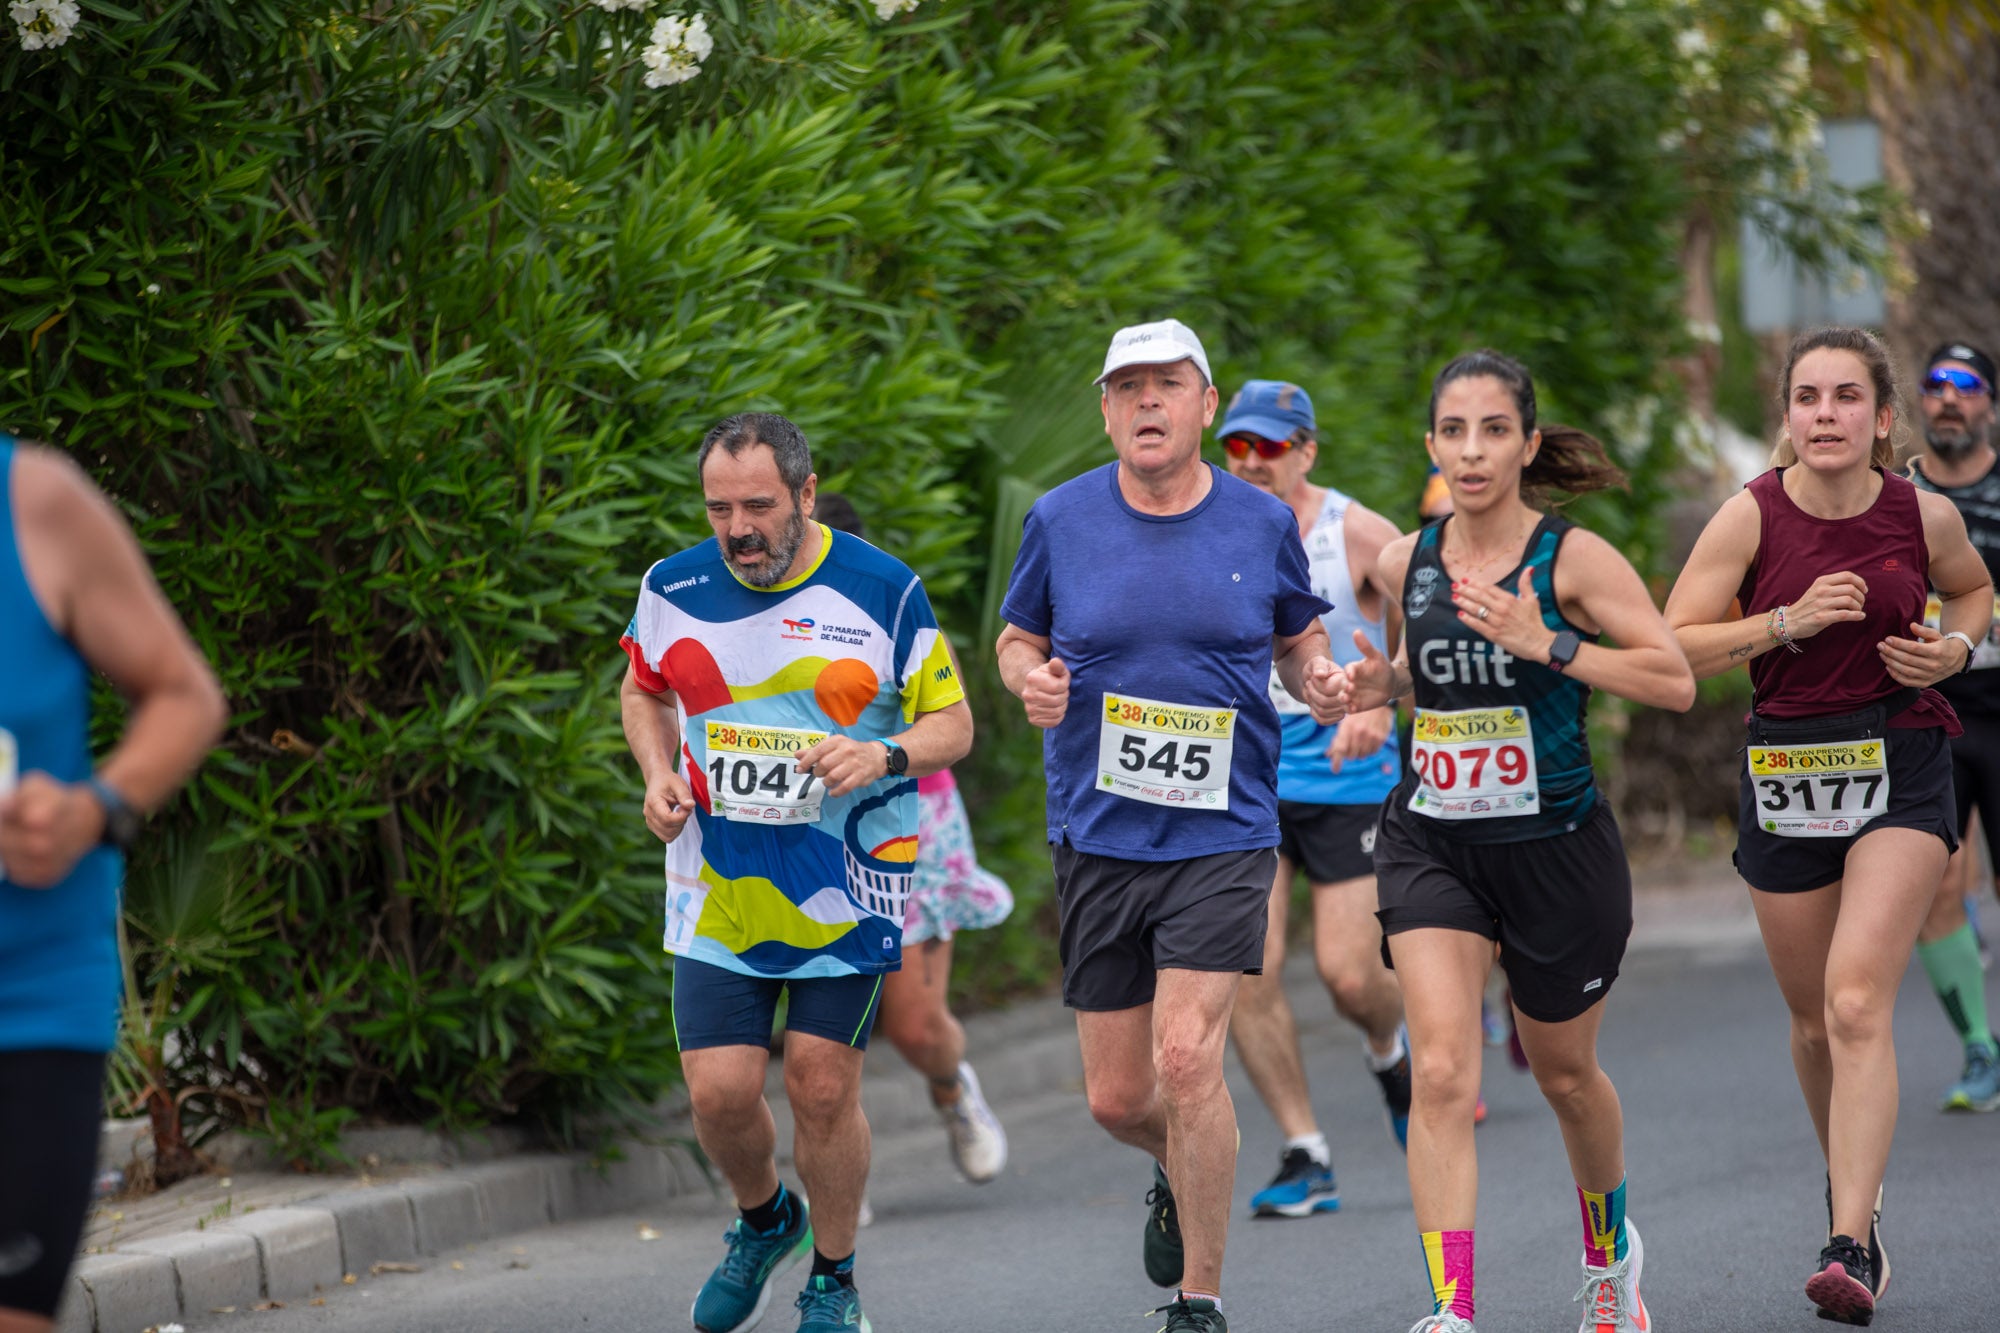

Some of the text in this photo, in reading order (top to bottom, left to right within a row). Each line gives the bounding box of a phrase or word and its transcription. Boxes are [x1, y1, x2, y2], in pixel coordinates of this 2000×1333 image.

[663, 576, 697, 594] luanvi
[820, 633, 864, 646] DE MÁLAGA
[822, 624, 871, 638] 1/2 MARATÓN
[1419, 638, 1516, 688] Giit
[1120, 703, 1205, 722] 38 GRAN PREMIO
[1141, 712, 1210, 732] FONDO
[720, 728, 796, 745] 38 GRAN PREMIO
[1434, 720, 1498, 737] ONDO
[737, 735, 801, 752] FONDO
[1119, 734, 1212, 781] 545
[1767, 751, 1788, 769] 38
[1790, 749, 1815, 757] GRAN
[1816, 747, 1849, 756] PREMIO
[1788, 753, 1856, 769] FONDO
[1415, 744, 1528, 791] 2079
[709, 756, 817, 800] 1047
[1759, 774, 1883, 812] 3177
